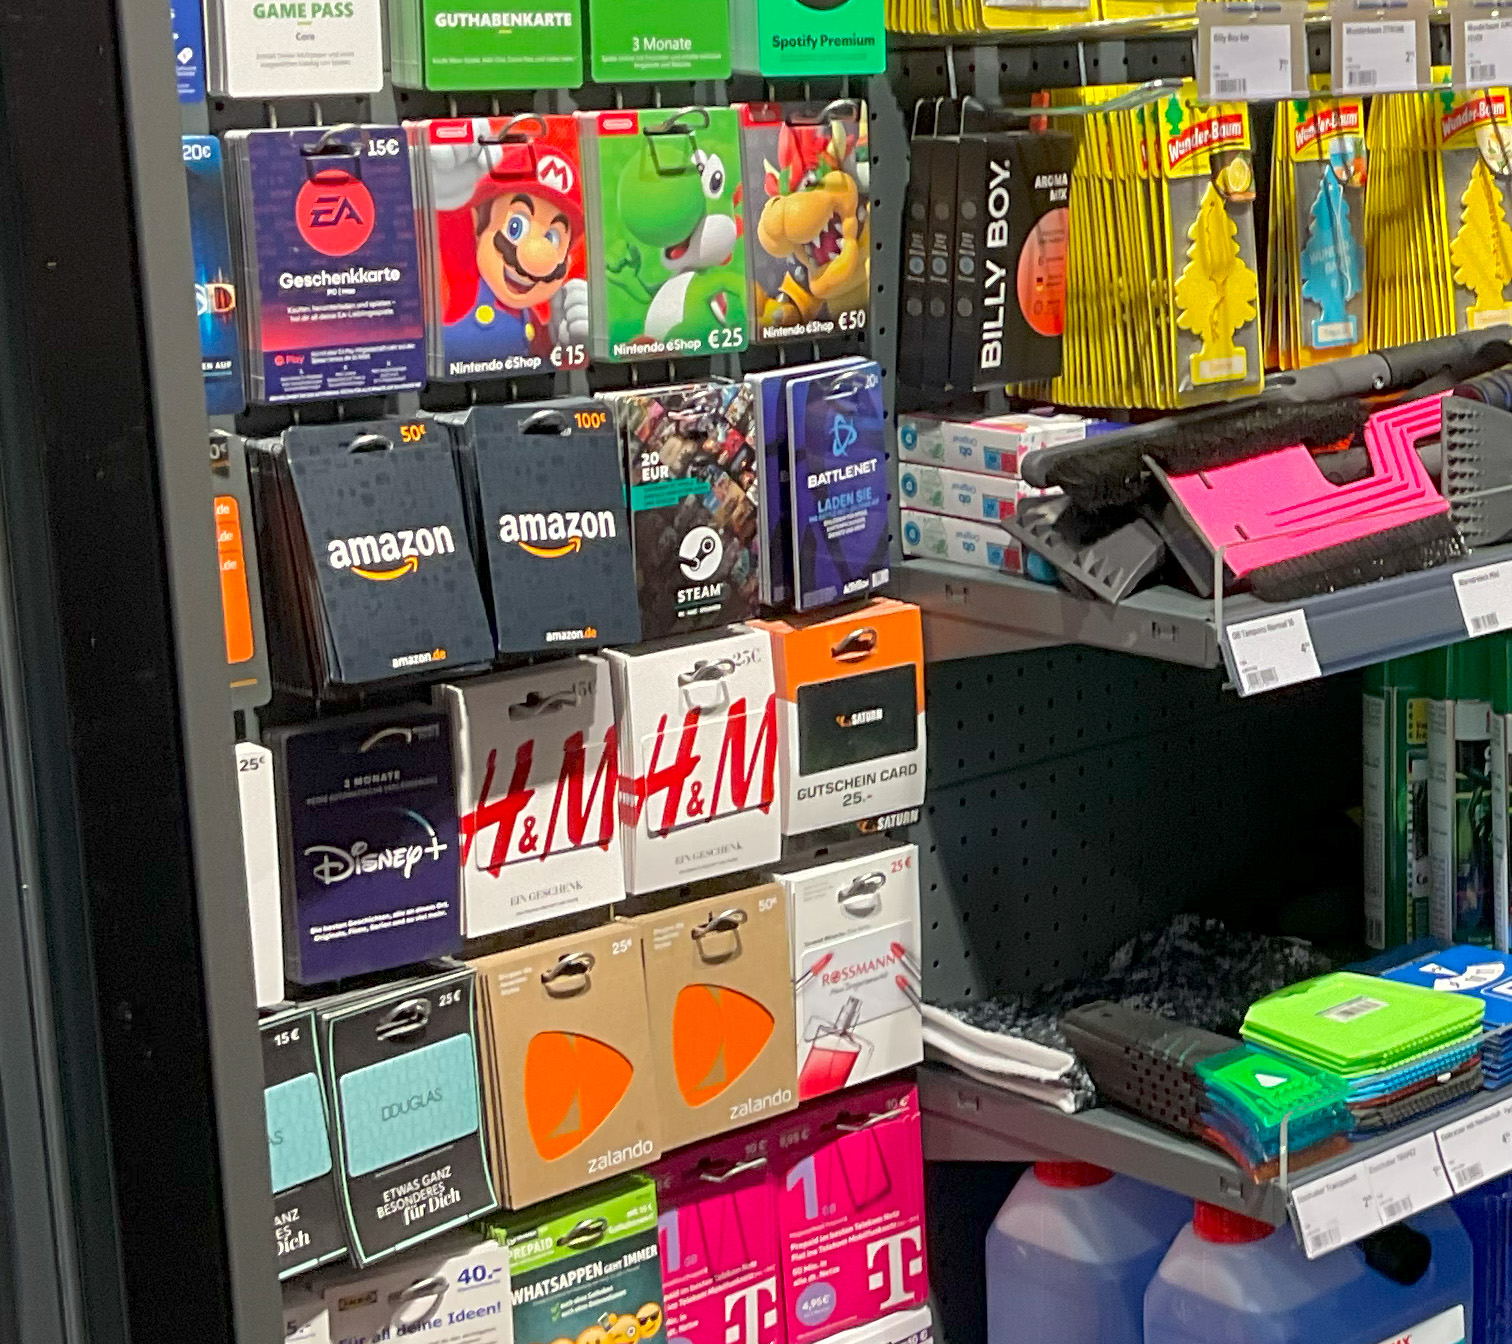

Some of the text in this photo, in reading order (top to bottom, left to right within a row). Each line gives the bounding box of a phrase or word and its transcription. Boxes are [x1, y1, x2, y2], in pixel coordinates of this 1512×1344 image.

[253, 1, 355, 20] GAME PASS
[434, 11, 573, 29] GUTHABENKARTE
[295, 31, 316, 43] Core
[632, 36, 693, 53] 3 Monate
[771, 33, 876, 51] Spotify Premium
[366, 137, 401, 158] 15€
[1168, 115, 1243, 164] Wunder-Baum
[1034, 173, 1069, 191] AROMA
[1049, 188, 1068, 203] MIX
[309, 194, 364, 229] EA
[980, 157, 1012, 370] BILLY BOY.
[278, 267, 402, 290] Geschenkkarte
[762, 324, 806, 339] Nintendo
[806, 320, 834, 334] eShop
[449, 355, 542, 376] Nintendo eShop
[641, 451, 660, 467] 20
[641, 464, 670, 482] EUR
[499, 508, 617, 544] amazon
[327, 524, 456, 570] amazon
[676, 584, 722, 605] STEAM
[545, 626, 598, 642] amazon.de
[391, 647, 447, 670] amazon.de
[851, 708, 883, 726] SATURN
[634, 692, 779, 839] H&M
[796, 762, 918, 801] GUTSCHEIN CARD
[460, 722, 620, 880] H&M
[877, 808, 920, 831] SATURN
[304, 831, 448, 887] Disney+
[527, 879, 584, 903] GESCHENK
[821, 953, 898, 987] ROSSMANN
[380, 1087, 444, 1122] DOUGLAS
[729, 1086, 793, 1121] zalando
[587, 1139, 654, 1175] zalando
[382, 1165, 453, 1204] ETWAS GANZ
[786, 1156, 819, 1221] 1
[376, 1181, 446, 1220] BESONDERES
[402, 1186, 462, 1226] für Dich
[456, 1265, 502, 1285] 40.-
[511, 1260, 604, 1306] WHATSAPPEN
[623, 1244, 658, 1268] IMMER
[371, 1325, 391, 1343] all
[396, 1316, 443, 1337] deine
[447, 1301, 502, 1326] Ideen!
